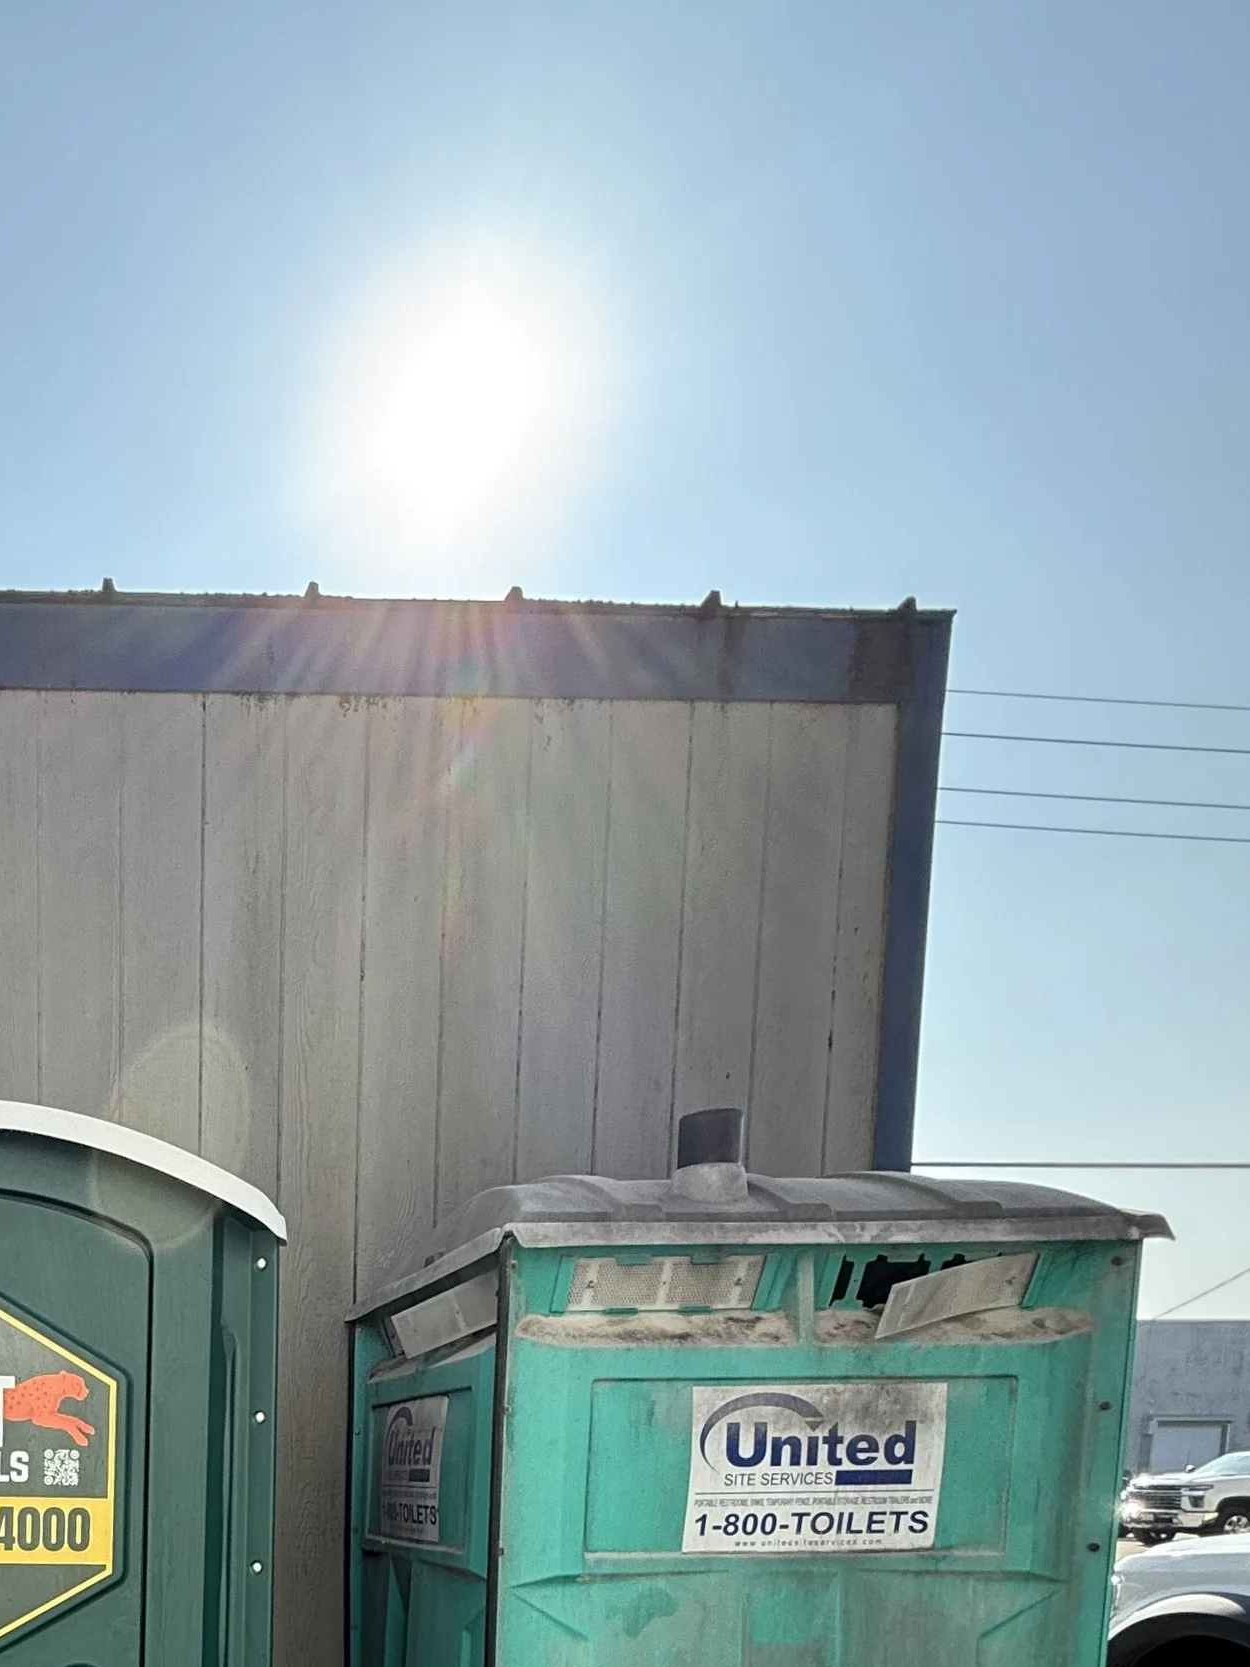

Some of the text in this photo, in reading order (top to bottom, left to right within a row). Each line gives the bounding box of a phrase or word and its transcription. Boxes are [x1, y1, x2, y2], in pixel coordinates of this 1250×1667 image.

[387, 1426, 436, 1467] United
[725, 1420, 917, 1468] United
[724, 1471, 834, 1487] SITE SERVICES
[694, 1510, 929, 1537] 1-800-TOILETS
